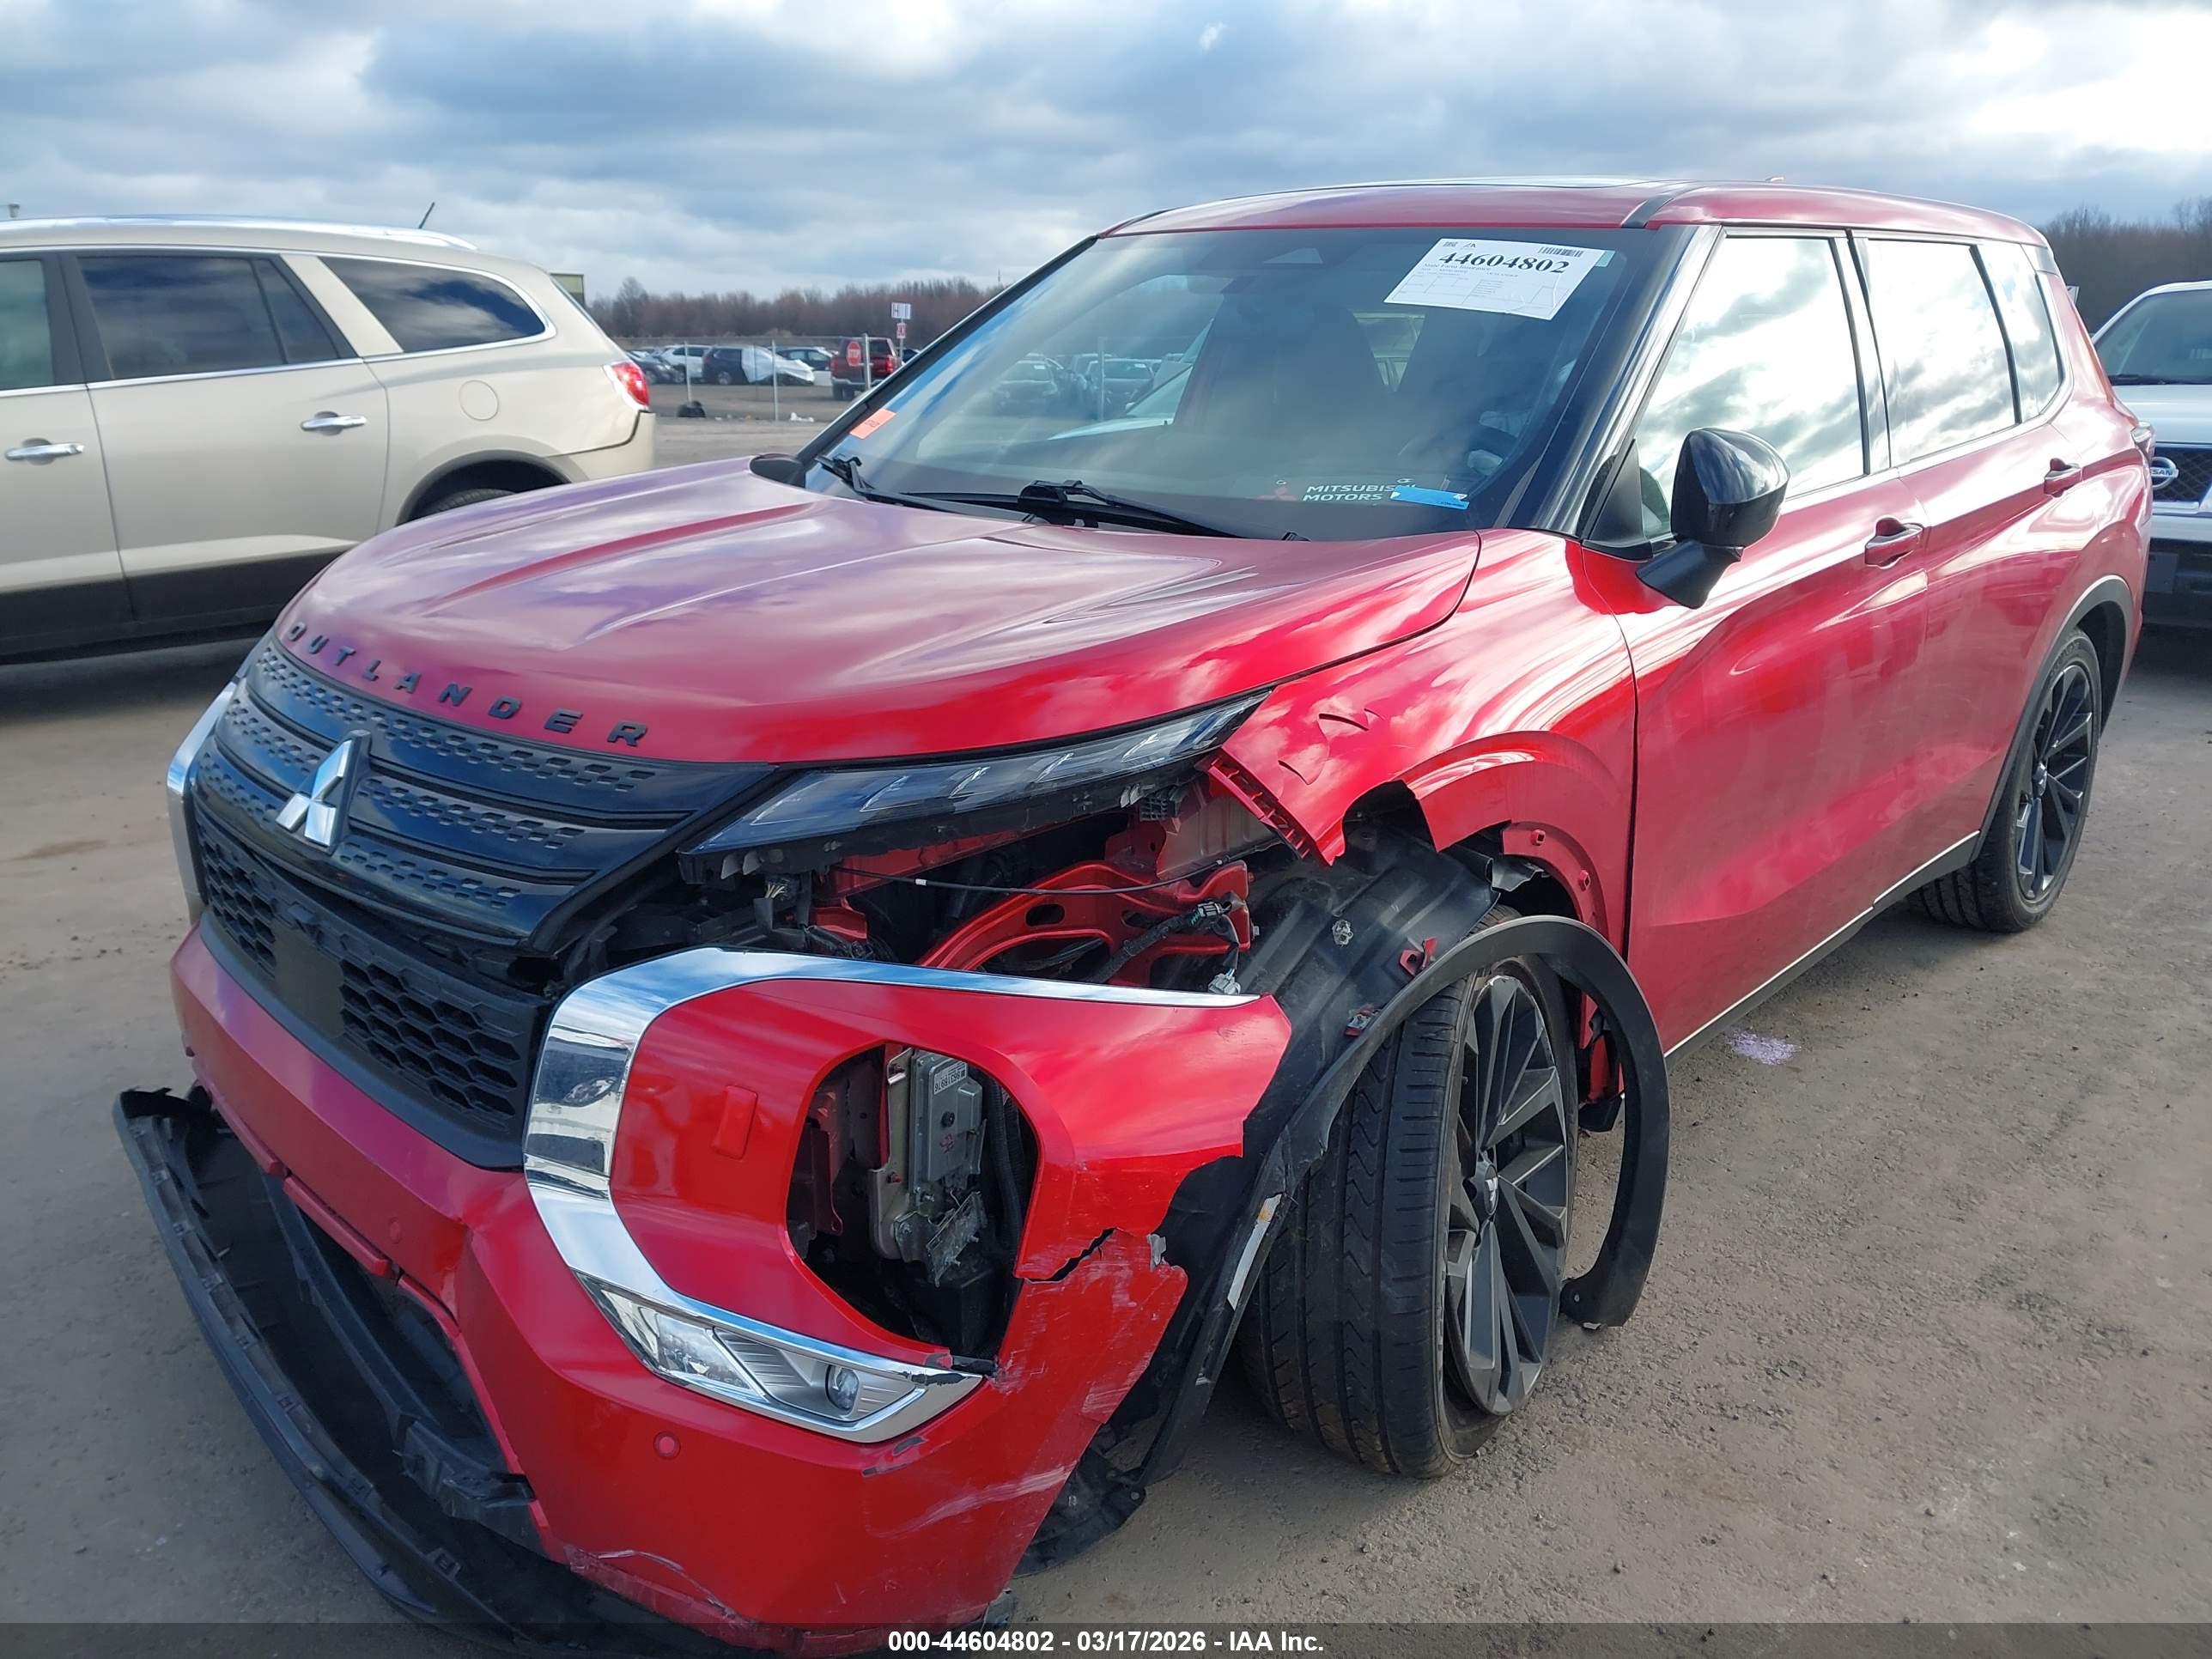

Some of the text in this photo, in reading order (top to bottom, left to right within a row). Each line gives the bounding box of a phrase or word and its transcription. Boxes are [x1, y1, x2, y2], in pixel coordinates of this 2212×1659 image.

[1439, 252, 1570, 273] 44604802
[1306, 484, 1415, 493] MITSUBIS
[1303, 493, 1382, 501] MOTORS
[288, 621, 648, 747] OUTLANDER
